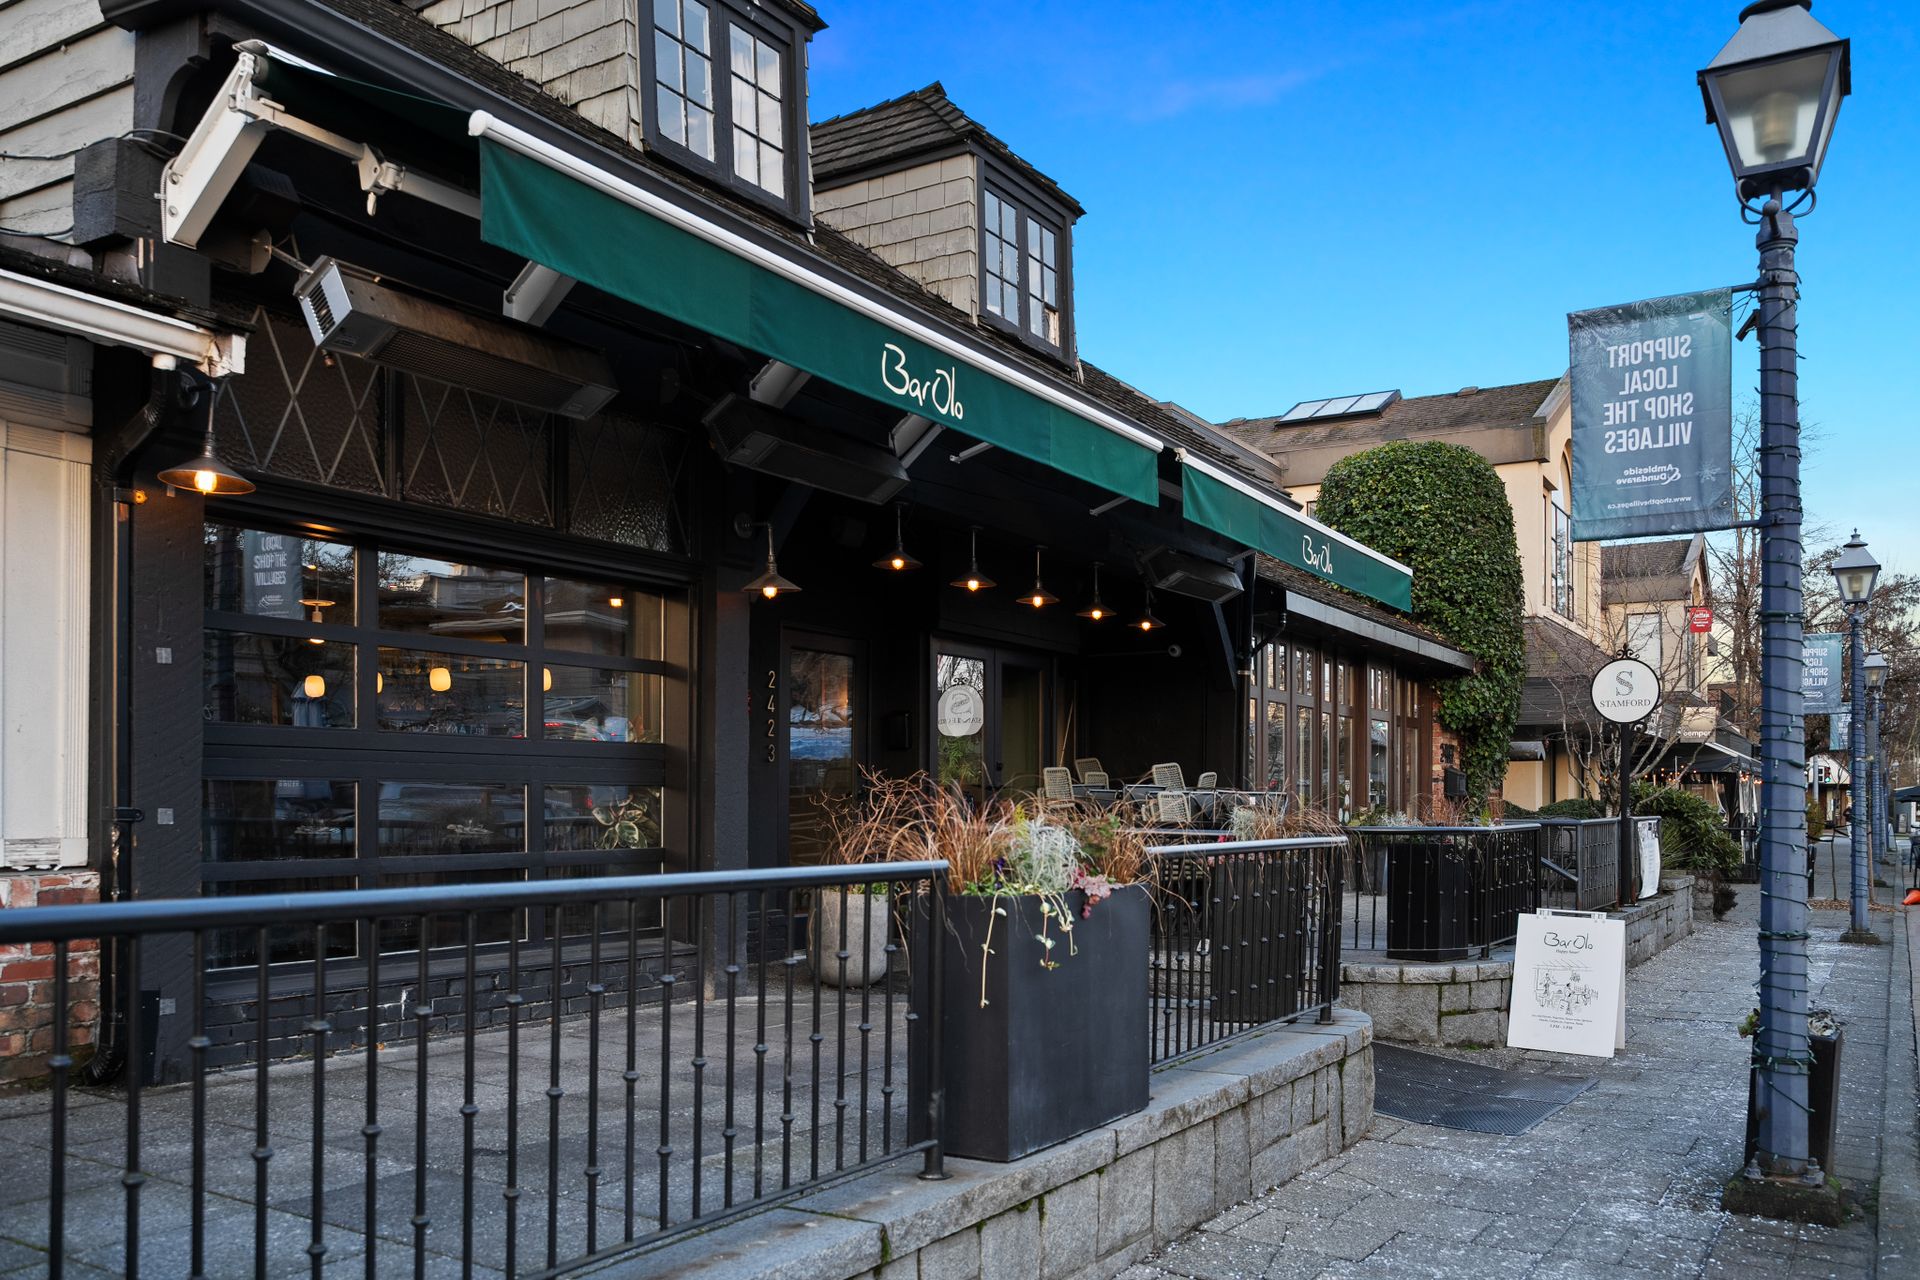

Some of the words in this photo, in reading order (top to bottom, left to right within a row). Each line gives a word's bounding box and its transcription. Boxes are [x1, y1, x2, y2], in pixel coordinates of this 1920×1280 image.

[1615, 670, 1634, 697] S
[767, 670, 777, 763] 2423
[1599, 698, 1651, 708] STAMFORD
